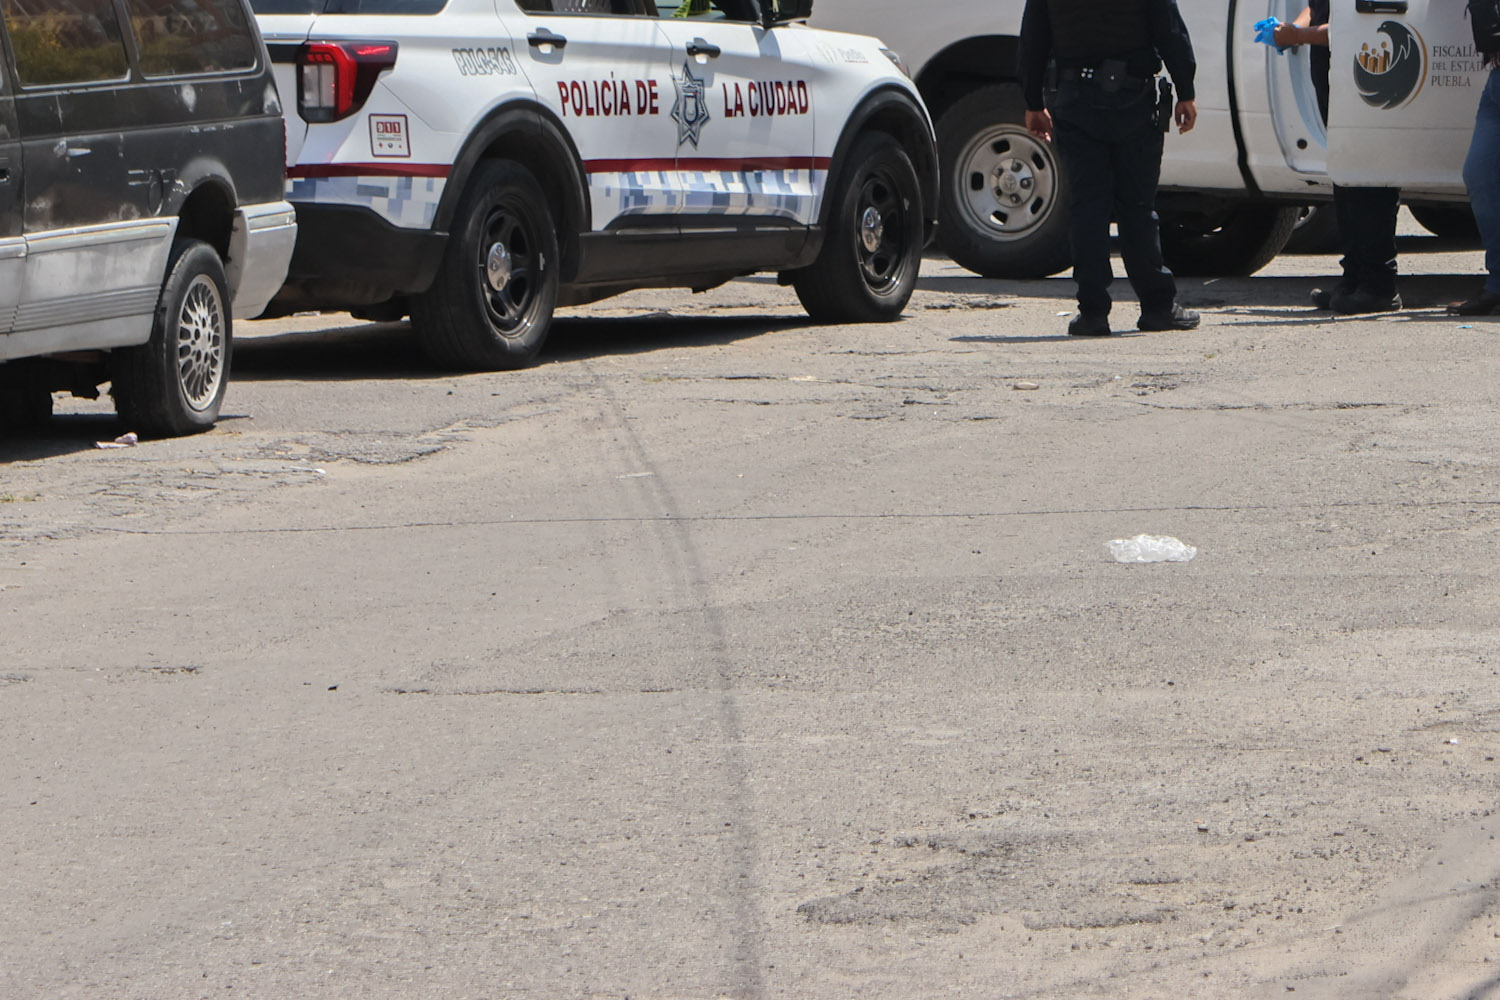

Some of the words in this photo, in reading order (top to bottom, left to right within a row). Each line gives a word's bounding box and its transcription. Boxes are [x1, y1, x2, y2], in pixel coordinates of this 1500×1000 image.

[1432, 62, 1448, 71] DEL
[1431, 75, 1471, 87] PUEBLA
[557, 71, 631, 117] POLICÍA
[634, 79, 659, 115] DE
[722, 81, 744, 118] LA
[748, 79, 809, 117] CIUDAD
[376, 121, 401, 134] 911
